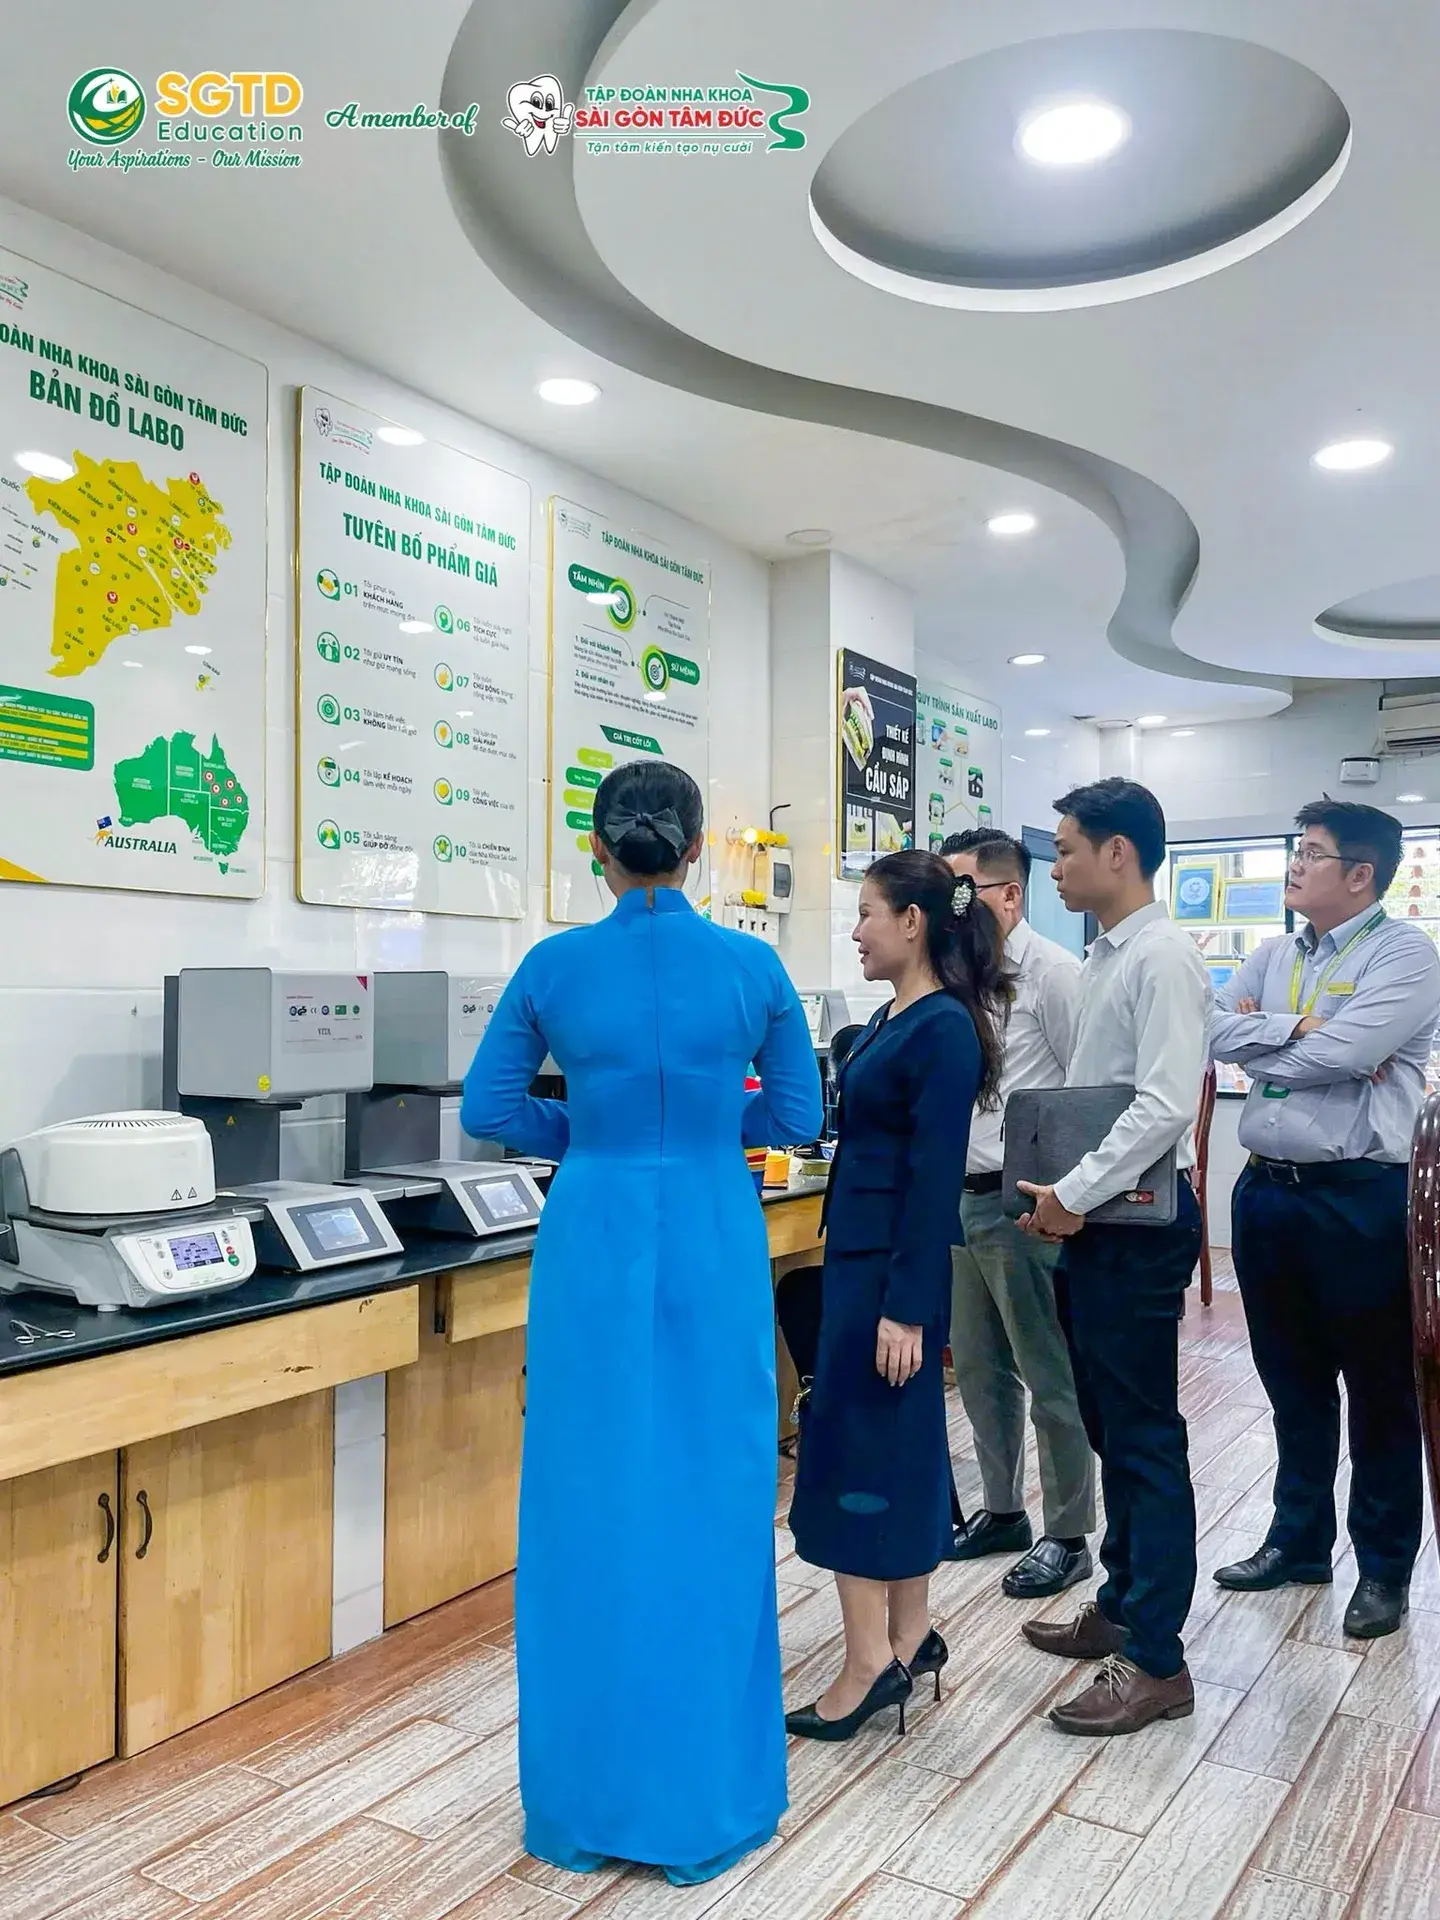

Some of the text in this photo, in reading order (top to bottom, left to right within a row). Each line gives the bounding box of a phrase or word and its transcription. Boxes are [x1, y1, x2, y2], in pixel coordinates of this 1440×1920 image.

[39, 339, 73, 369] NHA
[78, 354, 120, 387] KHOA
[124, 372, 149, 398] SÀI
[154, 385, 183, 411] GÒN
[187, 398, 217, 425] TÂM
[221, 411, 247, 437] ĐỨC
[30, 368, 184, 451] BẢN ĐỒ LABO
[319, 461, 516, 551] TẬP ĐOÀN NHA KHOA SÀI GÒN TÂM ĐỨC
[343, 512, 498, 587] TUYÊN BỐ PHẨM GIÁ
[344, 582, 358, 597] 01
[363, 591, 385, 604] KHÁCH
[456, 618, 470, 632] 06
[344, 645, 360, 661] 02
[456, 675, 469, 688] 07
[344, 707, 360, 722] 03
[363, 718, 386, 729] KHÔNG
[982, 716, 998, 730] LABO
[456, 732, 470, 745] 08
[344, 769, 360, 783] 04
[865, 761, 909, 800] CẦU SÁP
[456, 788, 470, 801] 09
[104, 835, 177, 854] AUSTRALIA
[344, 831, 360, 844] 05
[455, 845, 466, 857] 10
